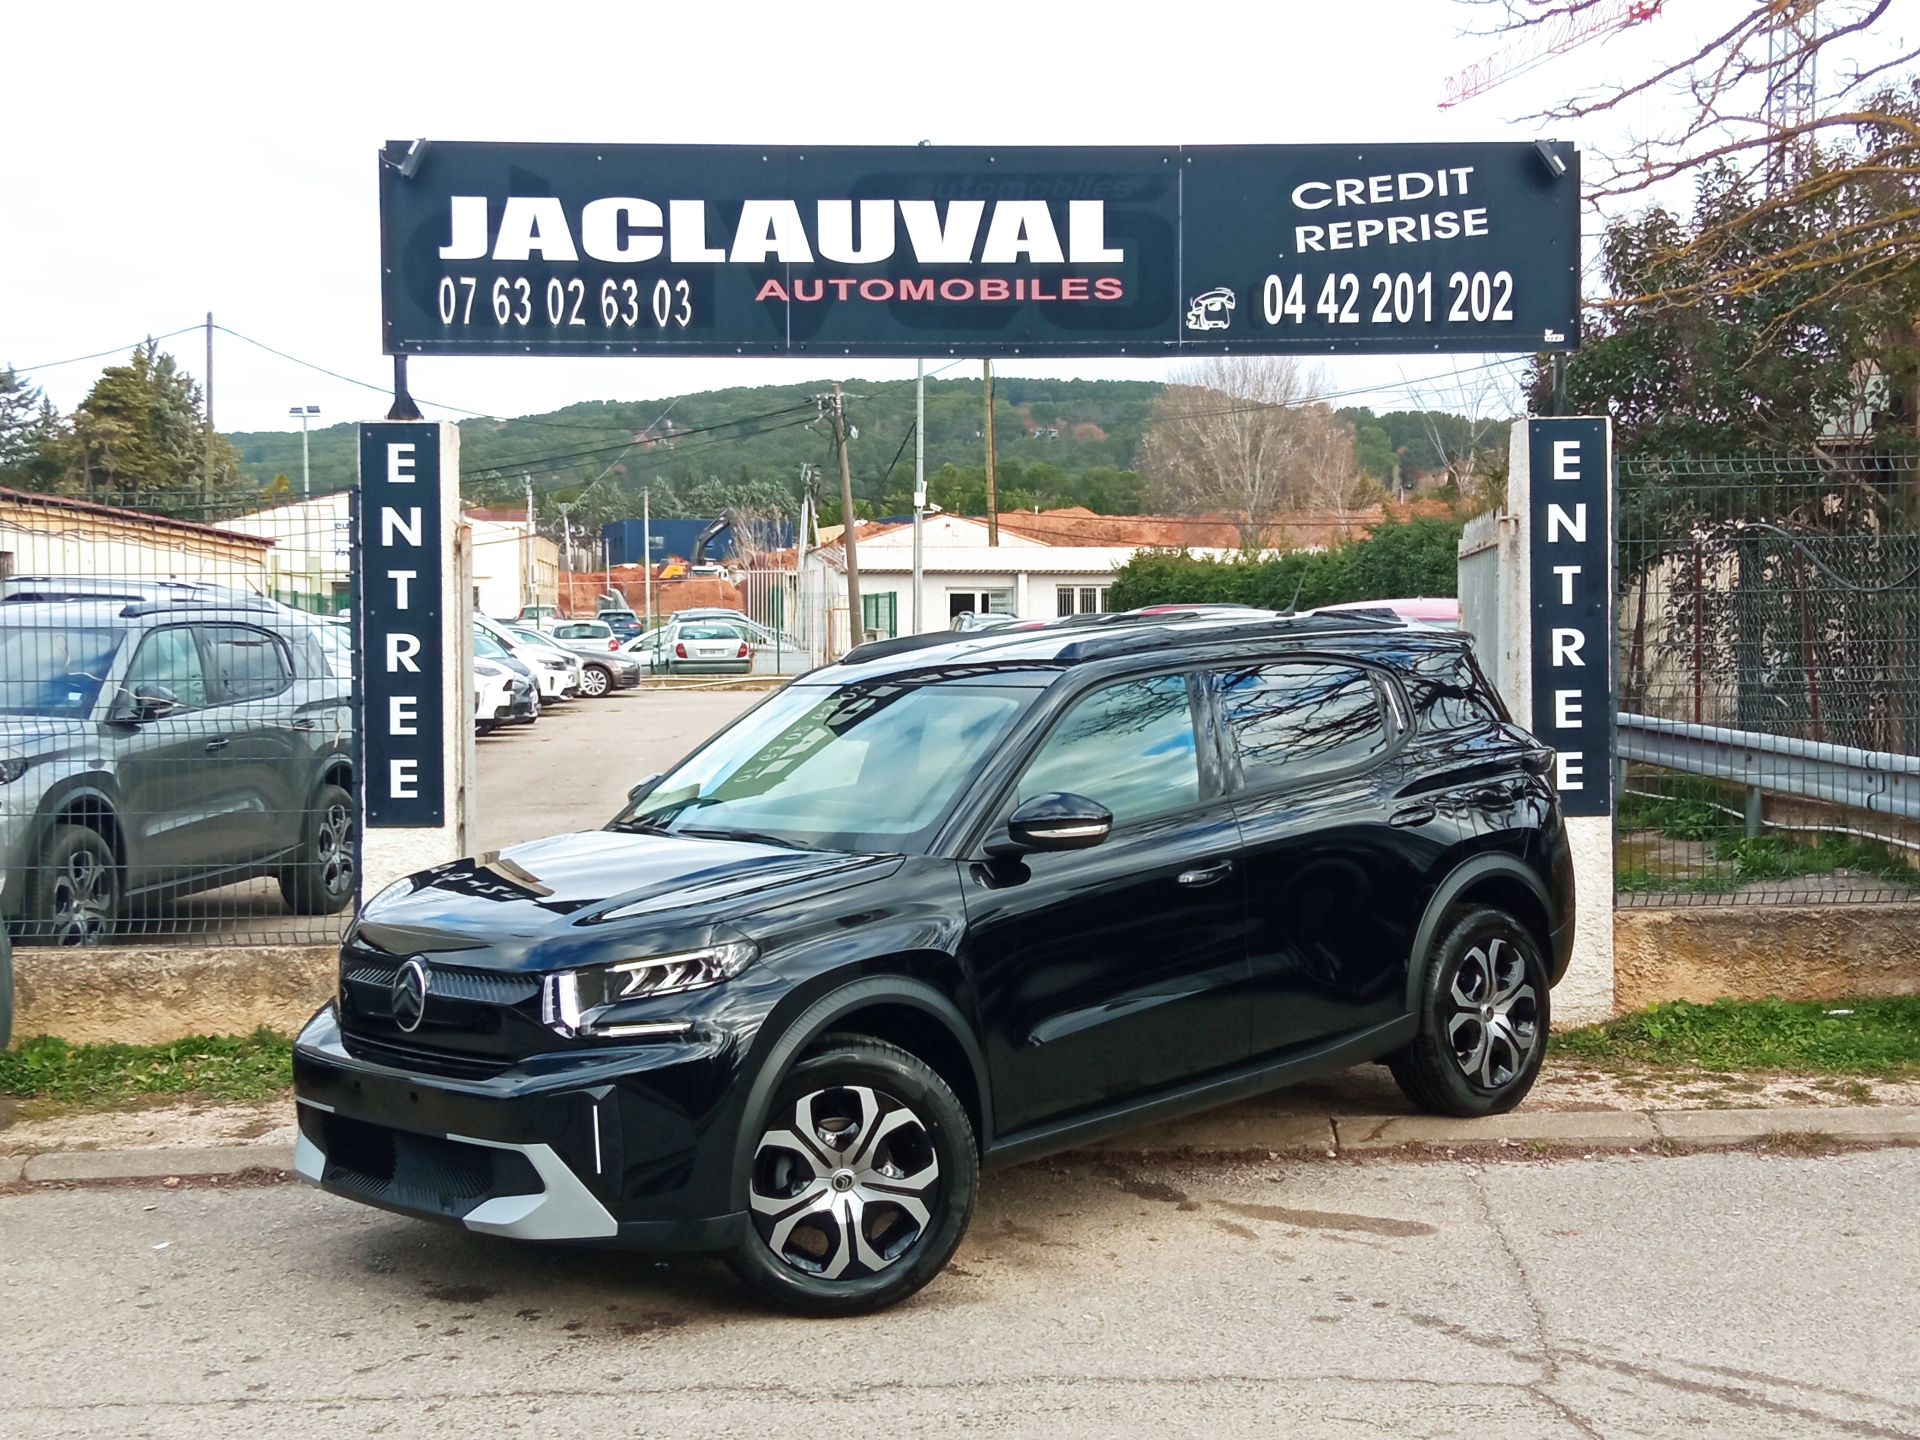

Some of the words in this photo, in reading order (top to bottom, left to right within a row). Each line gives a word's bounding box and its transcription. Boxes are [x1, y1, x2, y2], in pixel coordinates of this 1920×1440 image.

[1292, 166, 1473, 210] CREDIT
[438, 195, 1124, 264] JACLAUVAL
[1295, 207, 1489, 254] REPRISE
[439, 276, 477, 325] 07
[492, 276, 531, 327] 63
[546, 277, 586, 327] 02
[601, 278, 639, 329] 63
[652, 279, 692, 329] 03
[755, 277, 1123, 302] AUTOMOBILES
[1263, 273, 1306, 325] 04
[1316, 272, 1360, 324] 42
[1371, 271, 1432, 323] 201
[1448, 270, 1513, 322] 202
[381, 443, 422, 799] ENTREE
[1547, 440, 1587, 791] ENTREE
